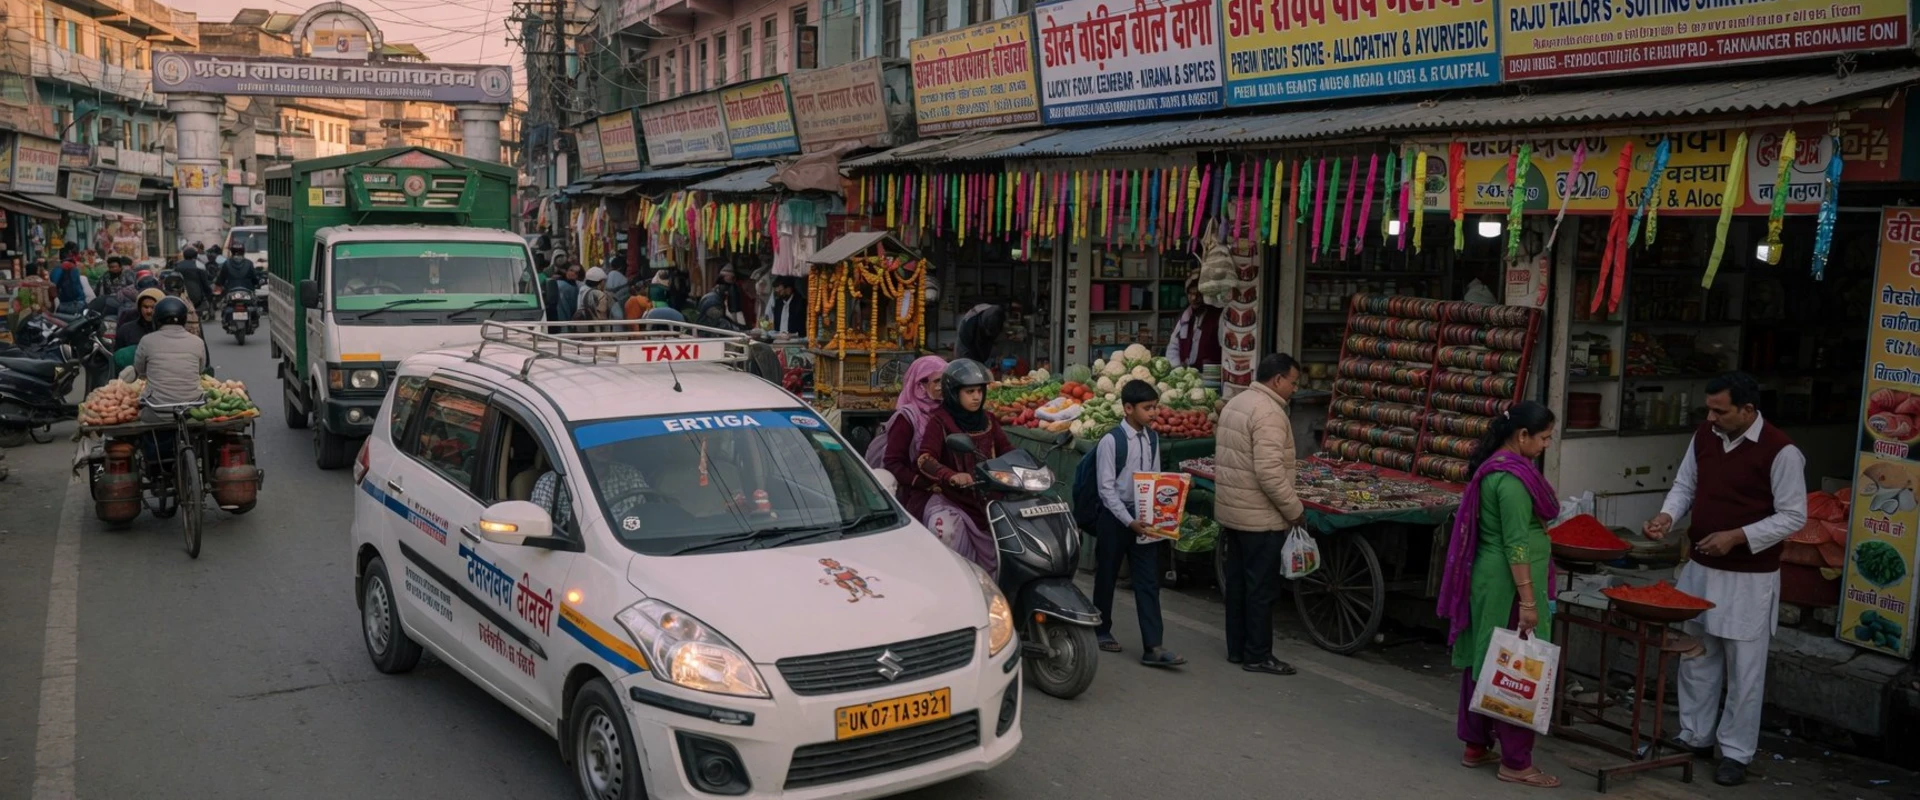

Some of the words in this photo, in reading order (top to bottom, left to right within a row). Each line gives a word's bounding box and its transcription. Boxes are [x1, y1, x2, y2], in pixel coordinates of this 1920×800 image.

[1510, 4, 1546, 32] RAJU
[1291, 41, 1325, 68] STORE
[1333, 31, 1398, 64] ALLOPATHY
[1402, 29, 1411, 56] &
[1415, 19, 1489, 55] AYURVEDIC
[1182, 60, 1217, 85] SPICES
[1667, 188, 1679, 207] &
[641, 343, 700, 362] TAXI
[661, 415, 762, 432] ERTIGA
[849, 713, 869, 732] UK
[872, 707, 890, 727] 07
